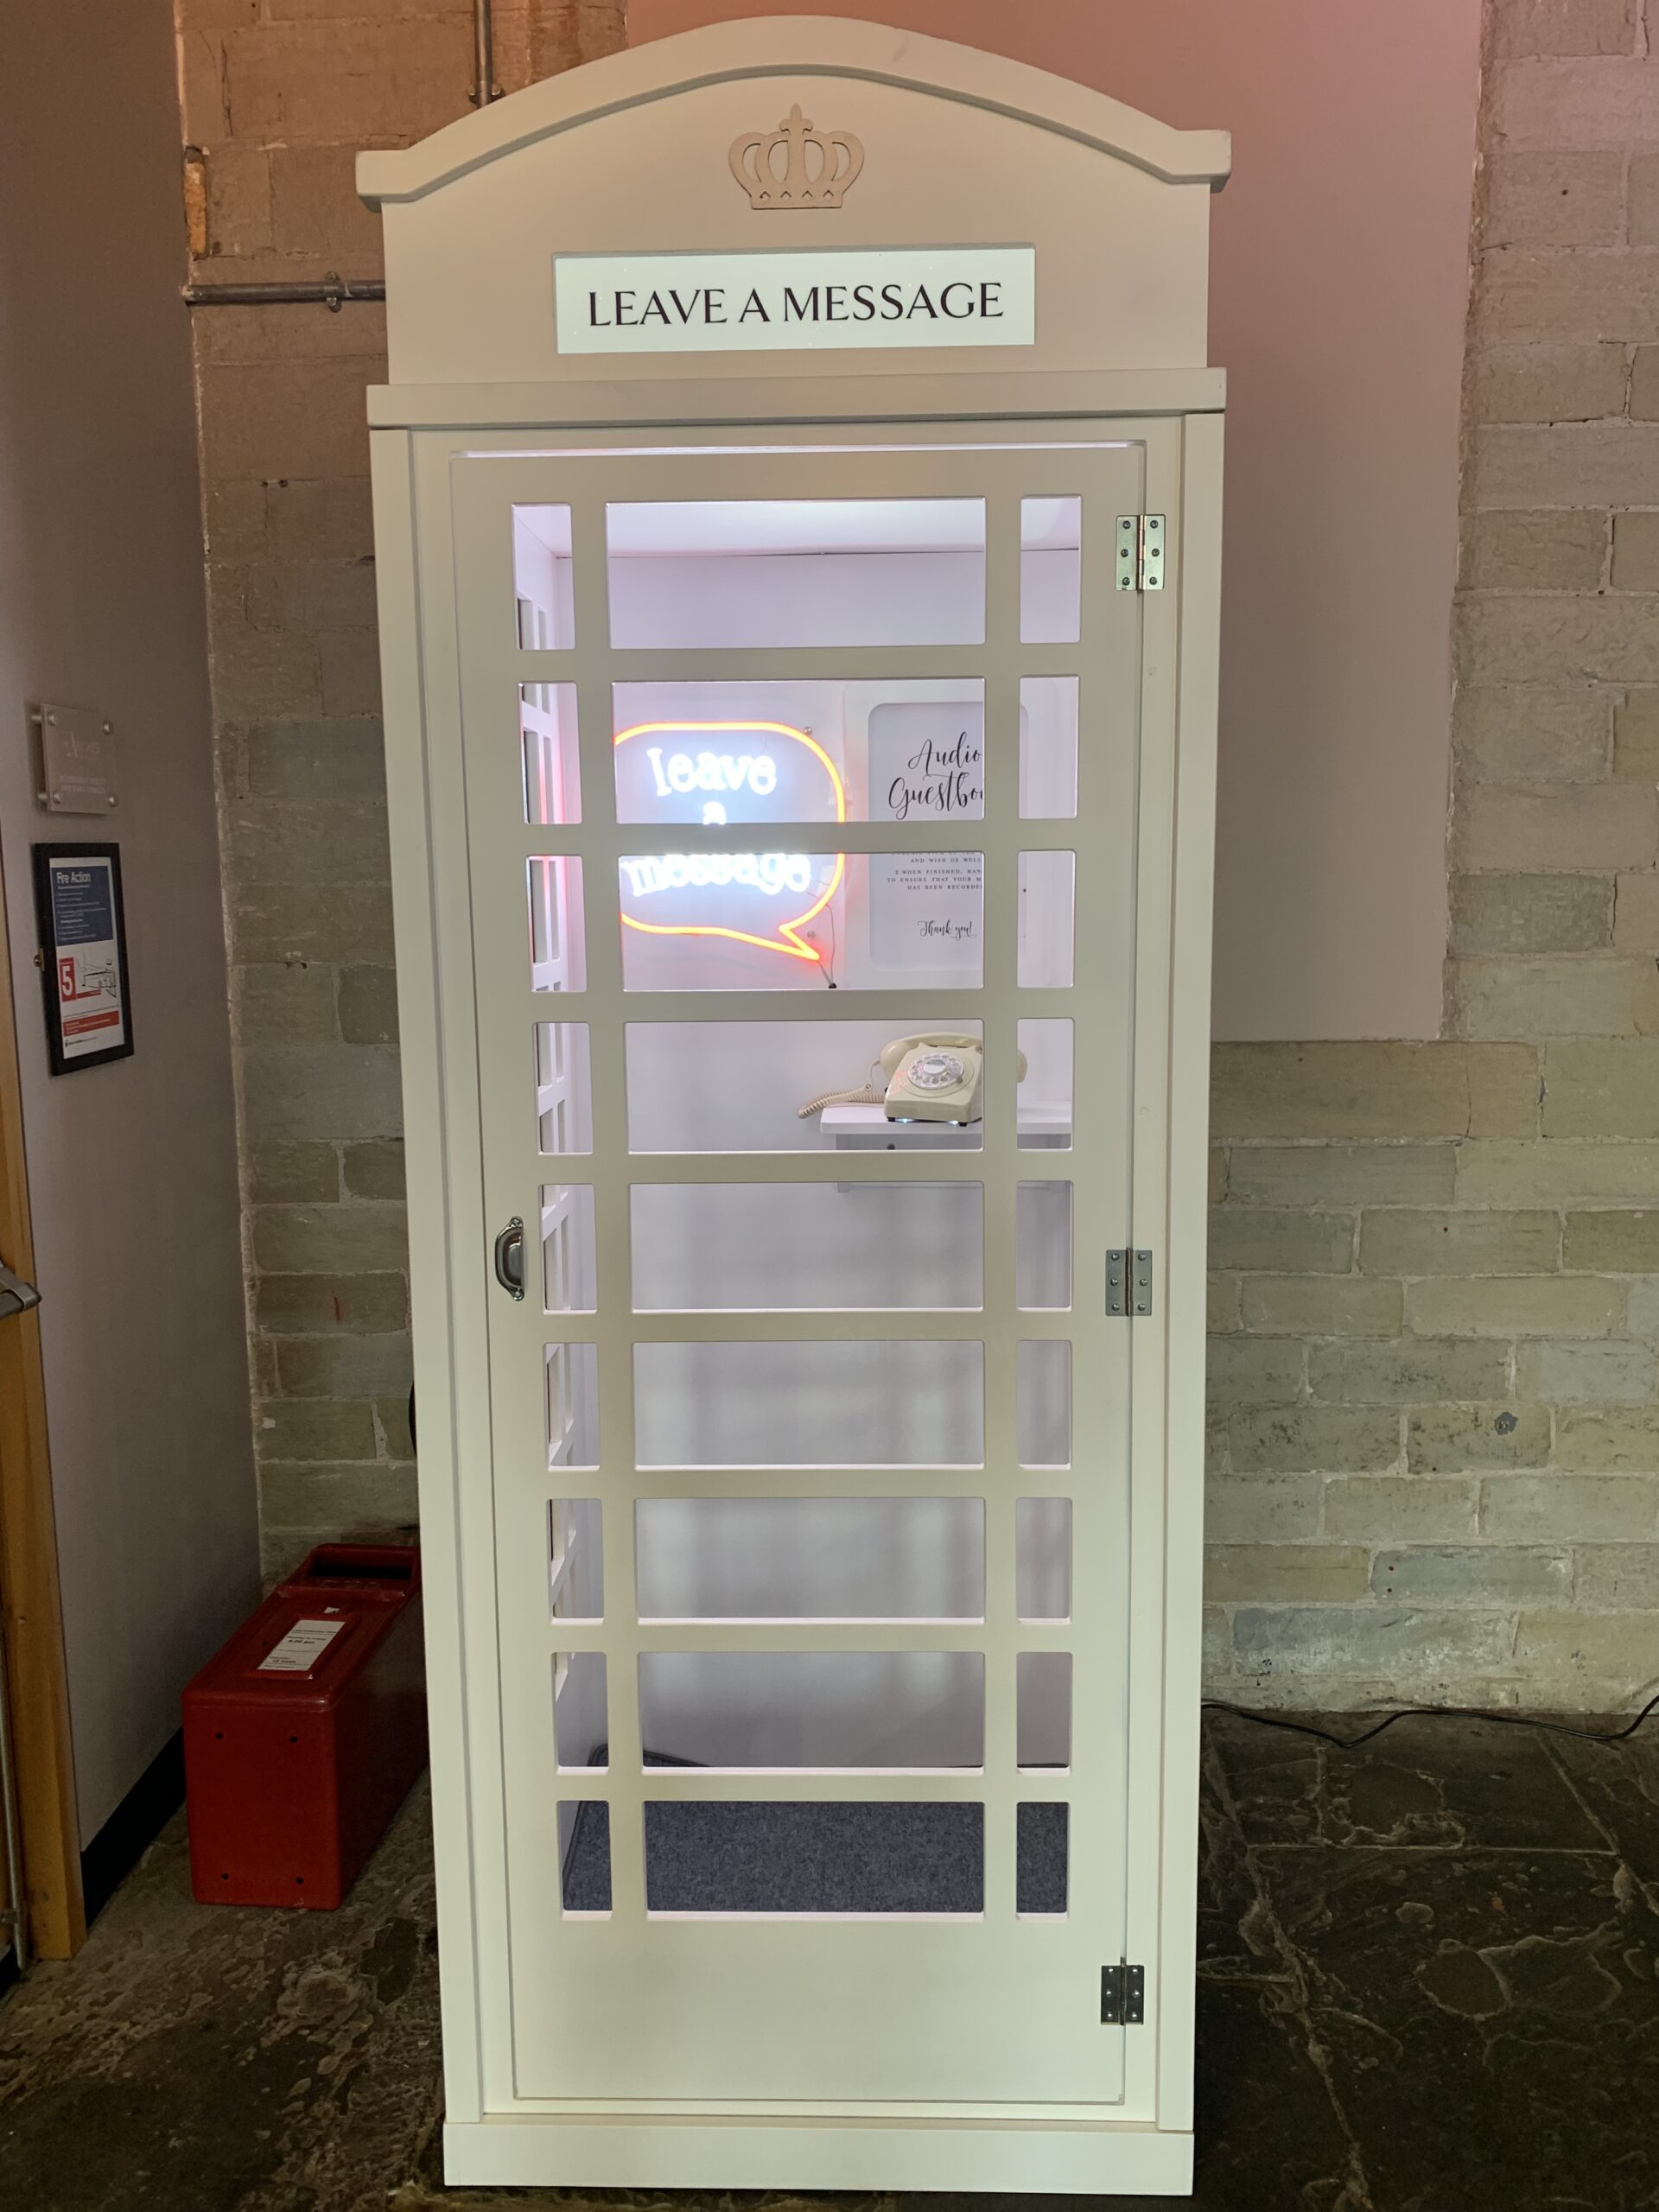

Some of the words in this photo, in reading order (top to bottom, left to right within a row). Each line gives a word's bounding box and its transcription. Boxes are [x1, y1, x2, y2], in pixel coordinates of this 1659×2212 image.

[588, 288, 728, 327] LEAVE
[738, 288, 771, 324] A
[783, 282, 1004, 322] MESSAGE
[646, 747, 777, 796] leave
[908, 732, 982, 777] Audio
[888, 770, 982, 820] Guestbo
[56, 871, 69, 884] Fire
[70, 871, 92, 883] Action
[917, 919, 952, 938] Thank
[61, 965, 73, 996] 5
